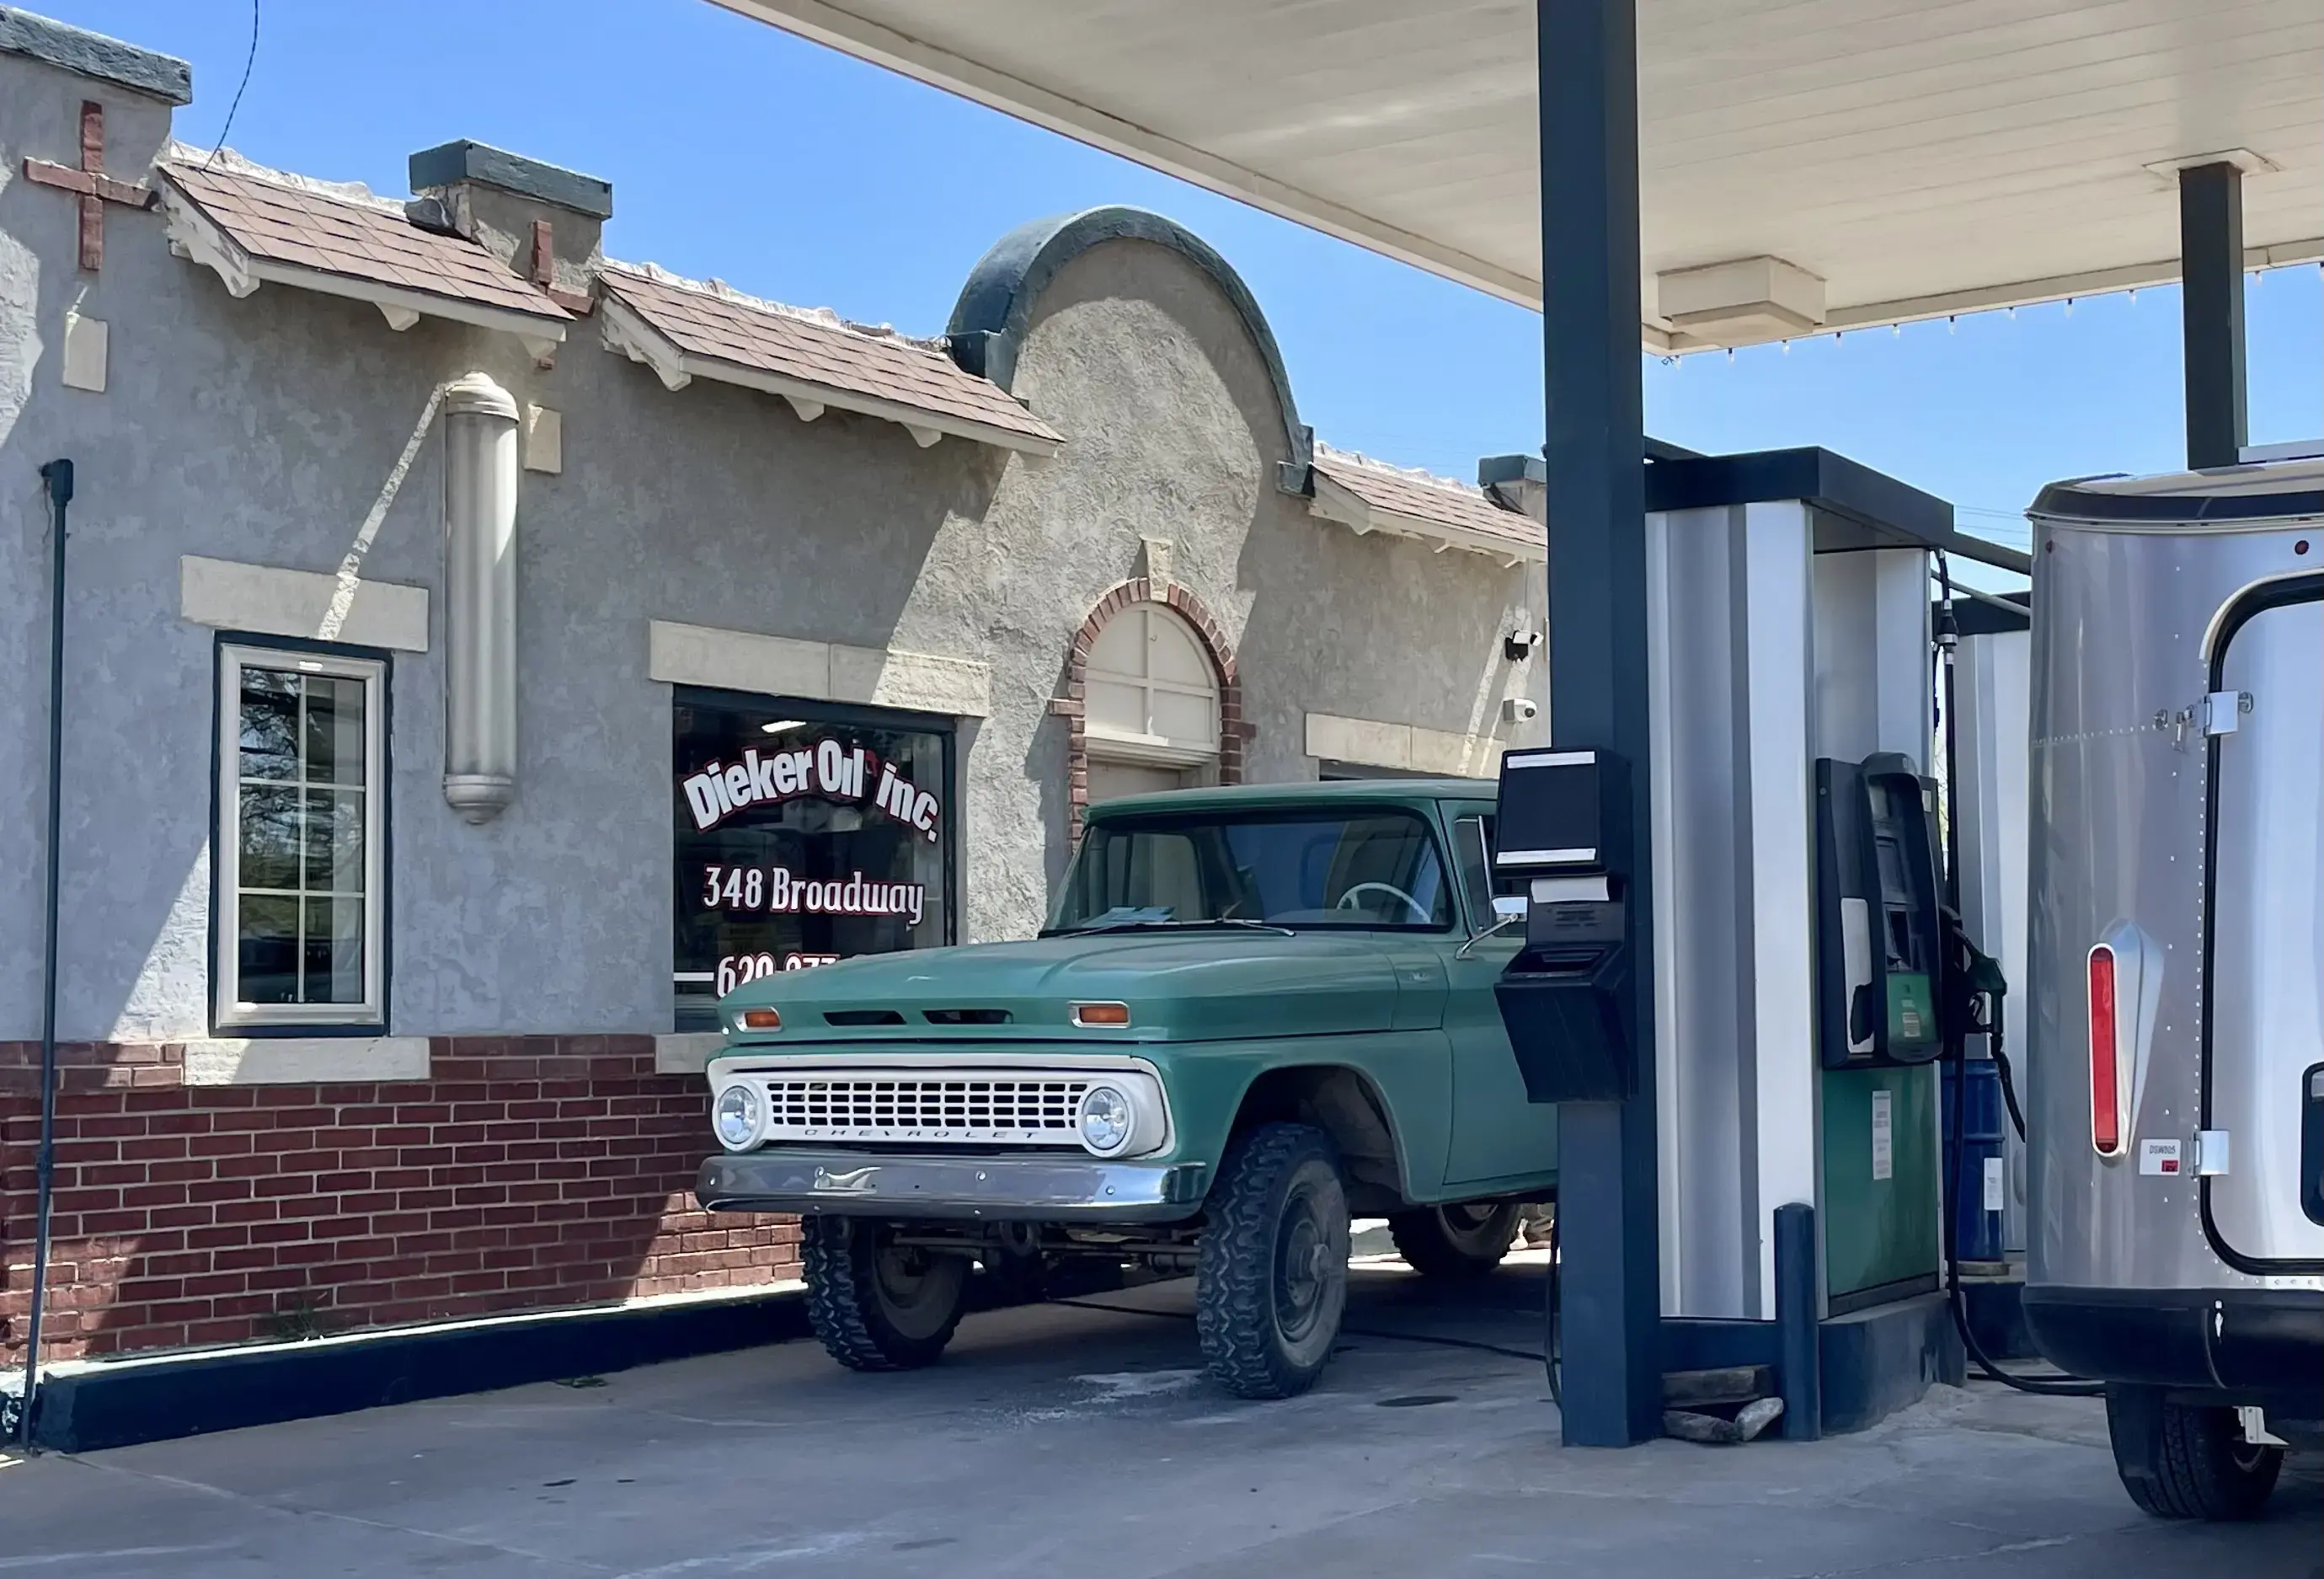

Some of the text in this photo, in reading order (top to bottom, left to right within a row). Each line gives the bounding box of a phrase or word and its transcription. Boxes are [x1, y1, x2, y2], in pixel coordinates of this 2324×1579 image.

[681, 747, 814, 830] Dieker
[816, 738, 865, 799] Oil
[703, 866, 924, 925] 348 Broadway
[804, 1129, 1039, 1139] CHEVROLET
